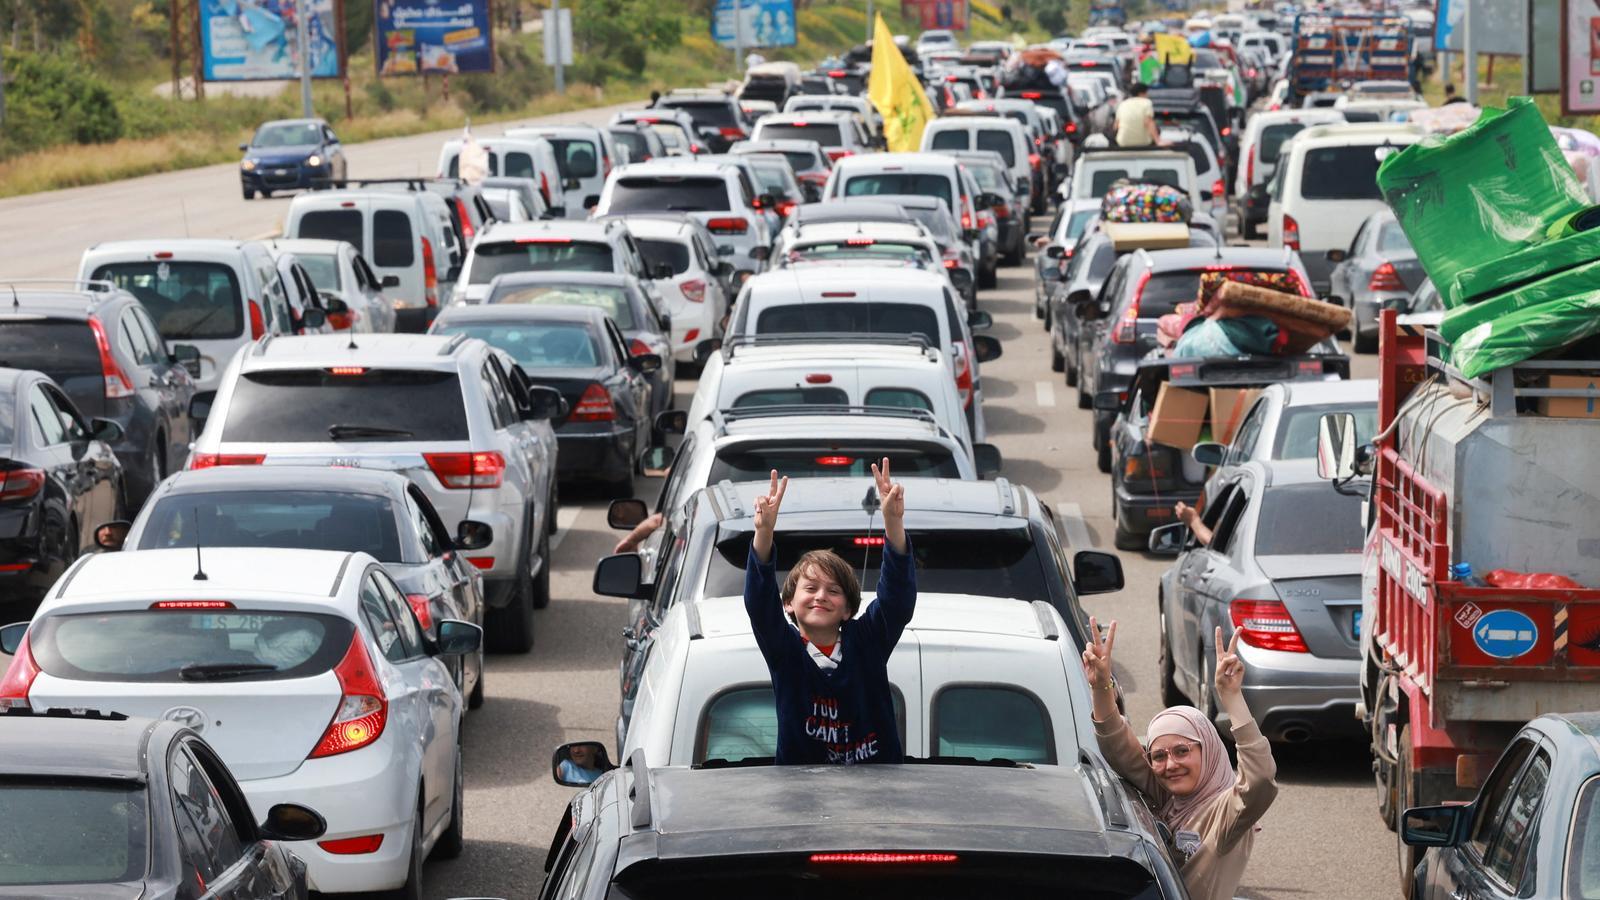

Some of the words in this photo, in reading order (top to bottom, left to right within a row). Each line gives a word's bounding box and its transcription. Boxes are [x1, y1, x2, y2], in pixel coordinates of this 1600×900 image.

[811, 696, 838, 719] YOU
[805, 716, 852, 743] CAN'T
[855, 732, 878, 760] ME
